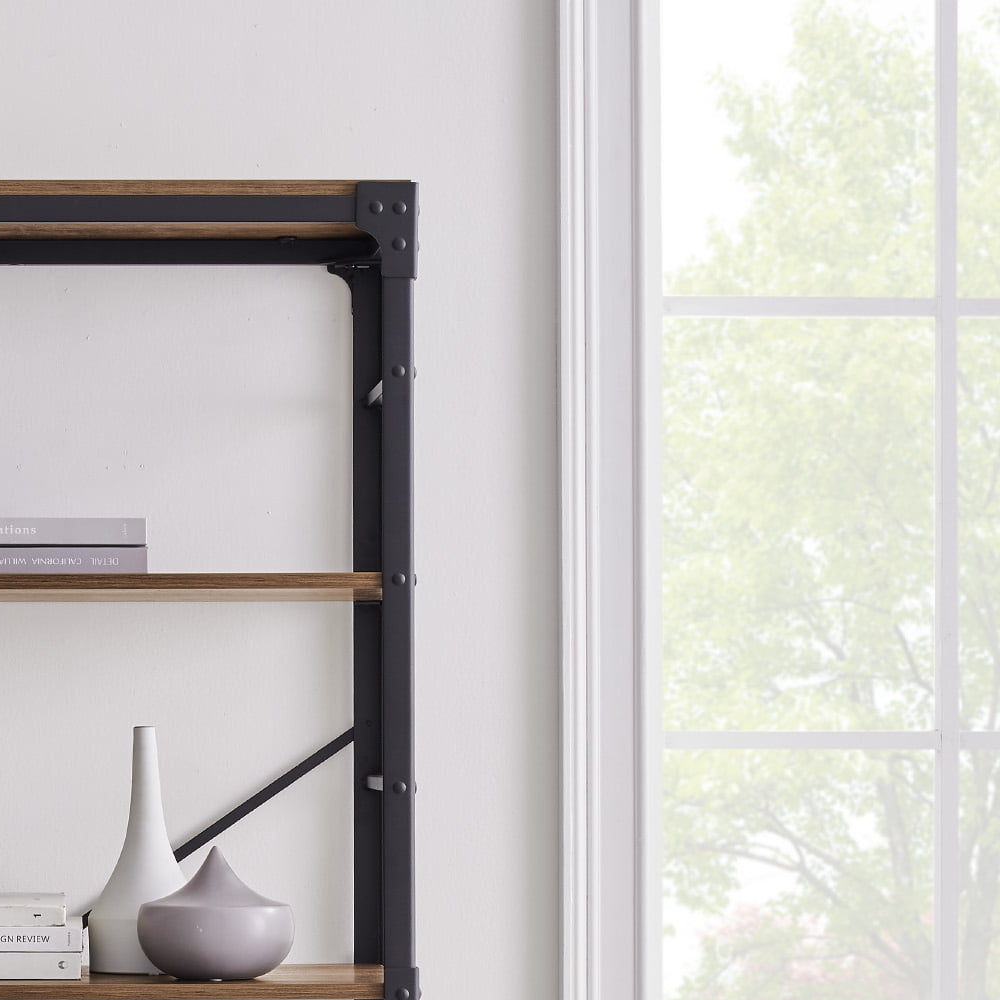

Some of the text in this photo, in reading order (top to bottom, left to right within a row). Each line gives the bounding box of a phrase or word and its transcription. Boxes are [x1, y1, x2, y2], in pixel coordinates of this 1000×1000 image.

[31, 557, 82, 565] CALIFORNIA
[89, 557, 119, 566] DETAIL
[16, 934, 50, 943] REVIEW
